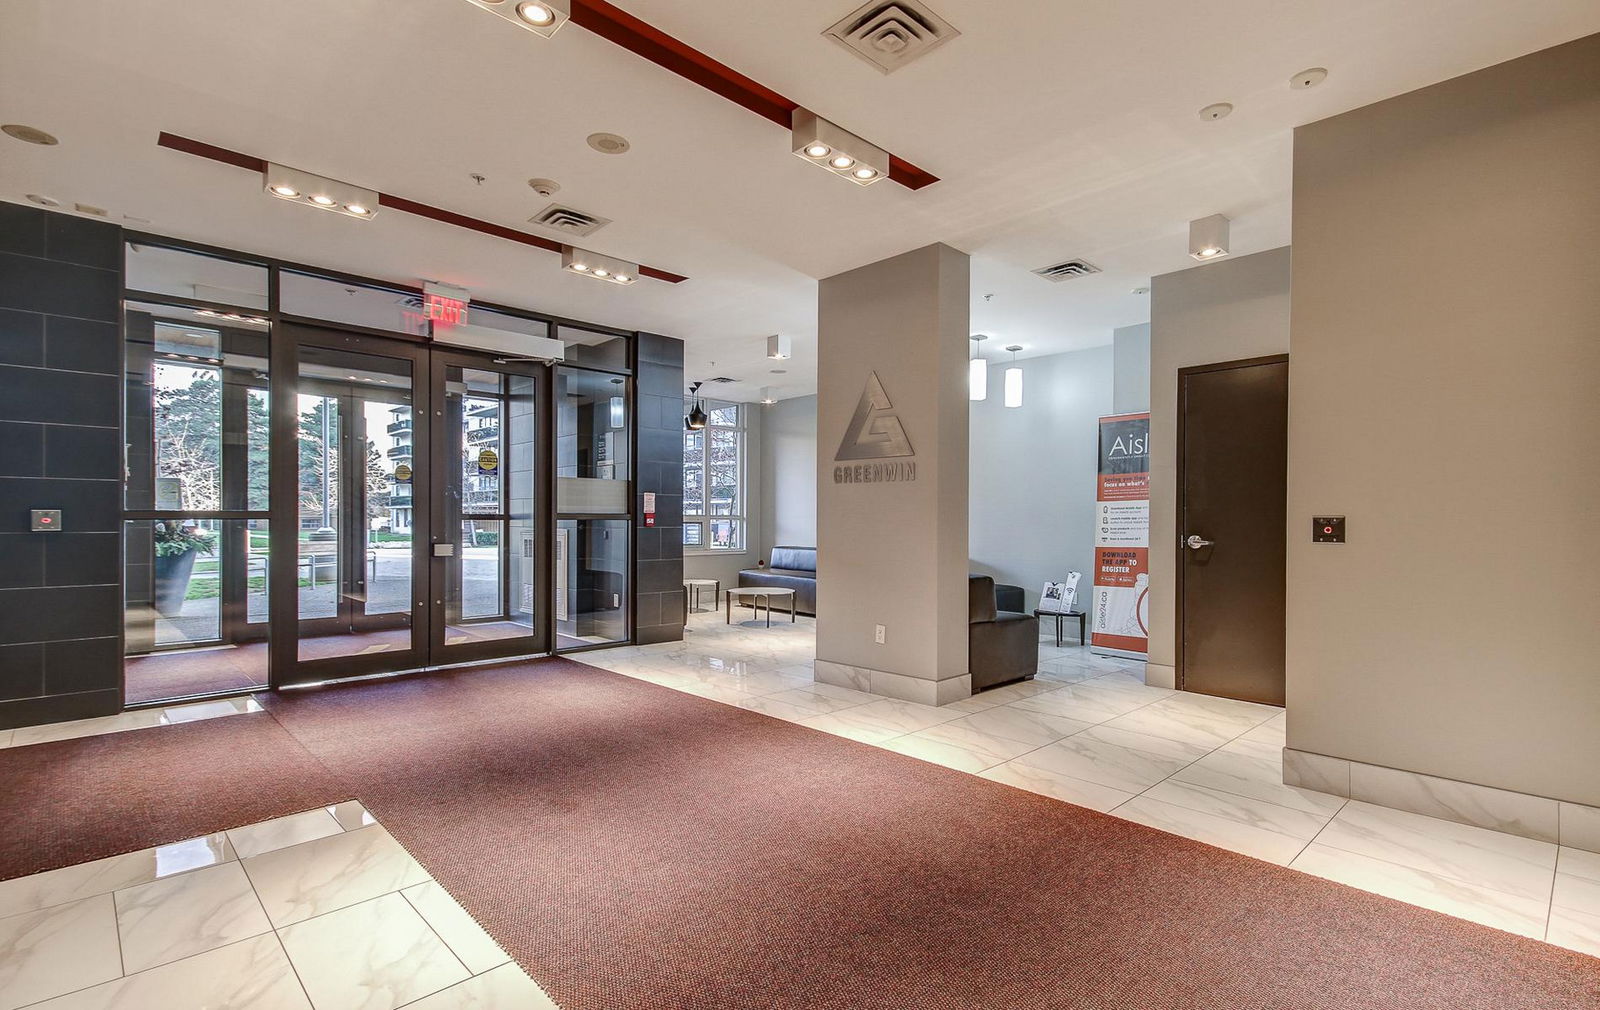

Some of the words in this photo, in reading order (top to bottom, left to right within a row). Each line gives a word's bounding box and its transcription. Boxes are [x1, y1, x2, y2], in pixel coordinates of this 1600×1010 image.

[430, 294, 464, 324] EXIT
[1109, 433, 1148, 456] Aisl
[833, 462, 917, 484] GREENWIN
[1101, 565, 1130, 573] REGISTER
